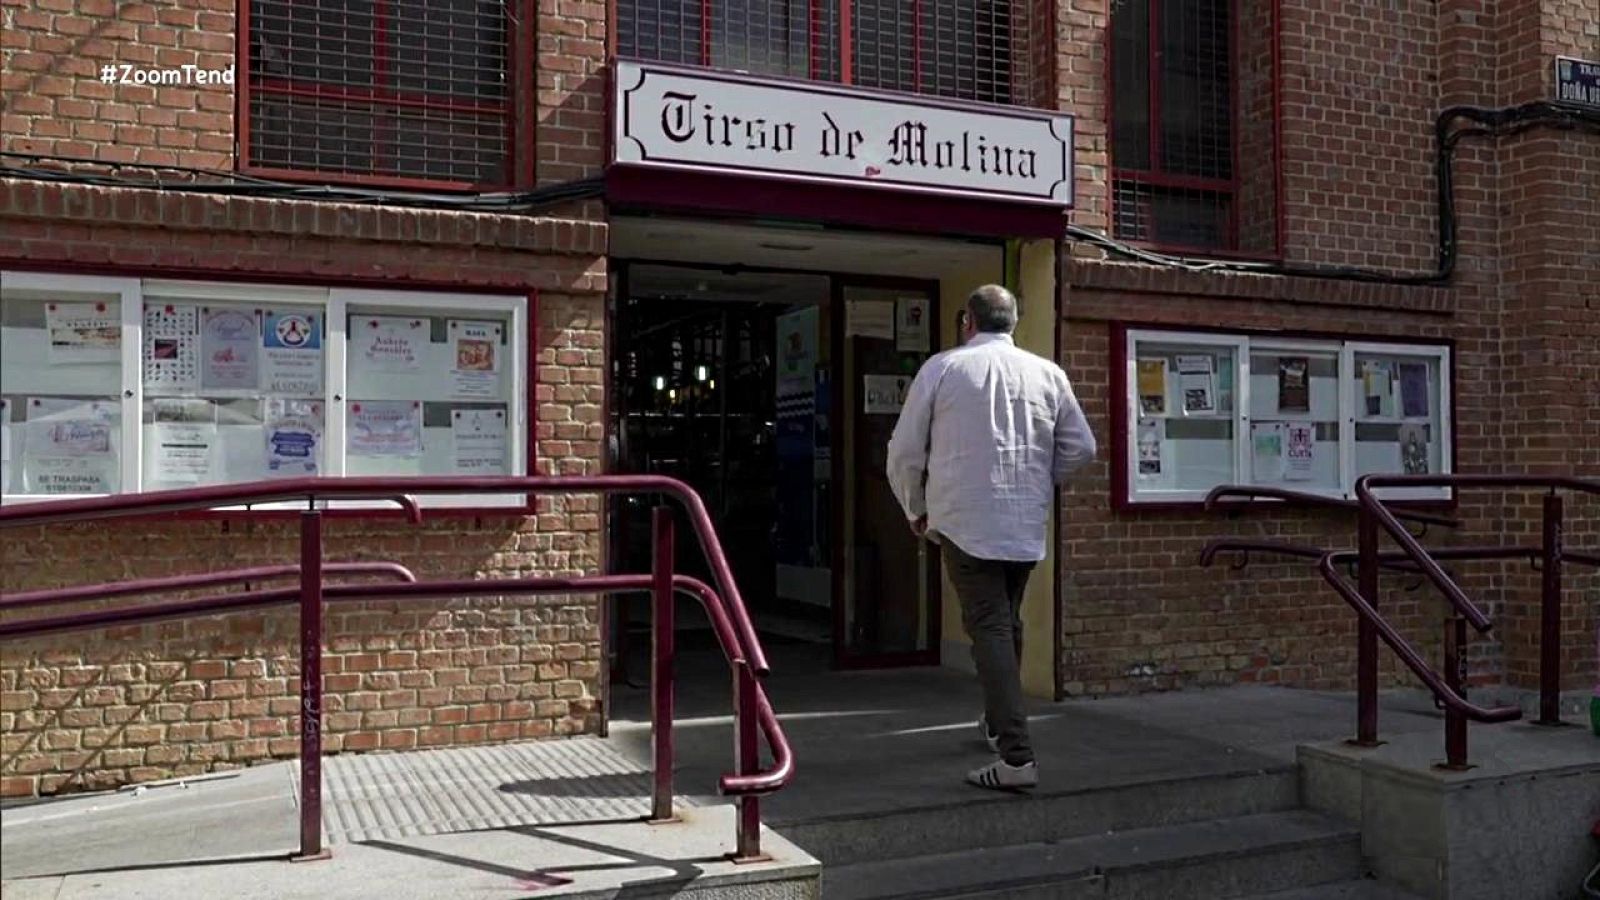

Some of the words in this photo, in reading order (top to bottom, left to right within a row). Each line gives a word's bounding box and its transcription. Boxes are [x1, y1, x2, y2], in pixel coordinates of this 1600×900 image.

[661, 91, 796, 153] Tirso
[819, 111, 864, 160] de
[887, 120, 1037, 178] Molina
